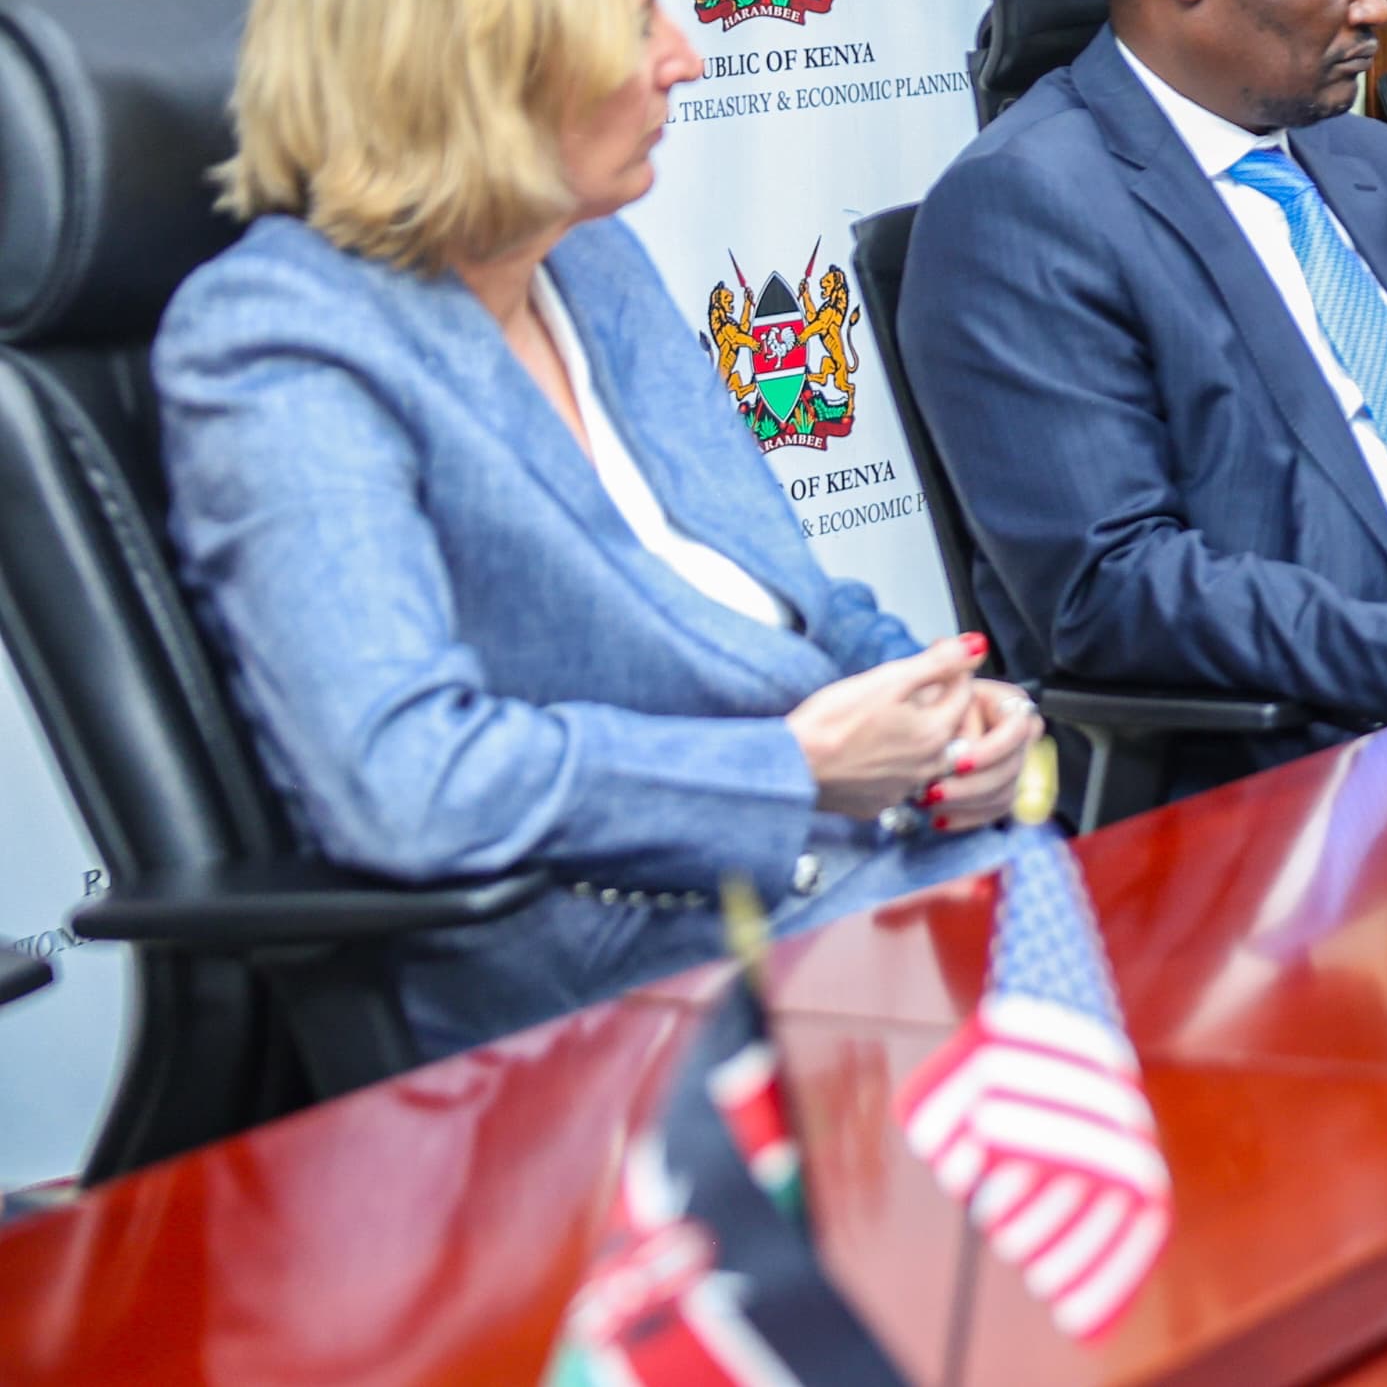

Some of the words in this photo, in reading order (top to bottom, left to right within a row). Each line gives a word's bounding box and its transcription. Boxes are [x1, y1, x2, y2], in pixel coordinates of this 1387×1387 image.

[723, 5, 801, 30] HARAMBEE
[702, 52, 760, 80] UBLIC
[766, 49, 798, 73] OF
[804, 41, 876, 69] KENYA
[679, 91, 773, 123] TREASURY
[776, 89, 792, 111] &
[796, 79, 893, 110] ECONOMIC
[895, 71, 969, 99] PLANNIN
[761, 434, 824, 452] RAMBEE
[790, 475, 821, 502] OF
[826, 460, 897, 495] KENYA
[801, 517, 815, 540] &
[818, 495, 913, 536] ECONOMIC
